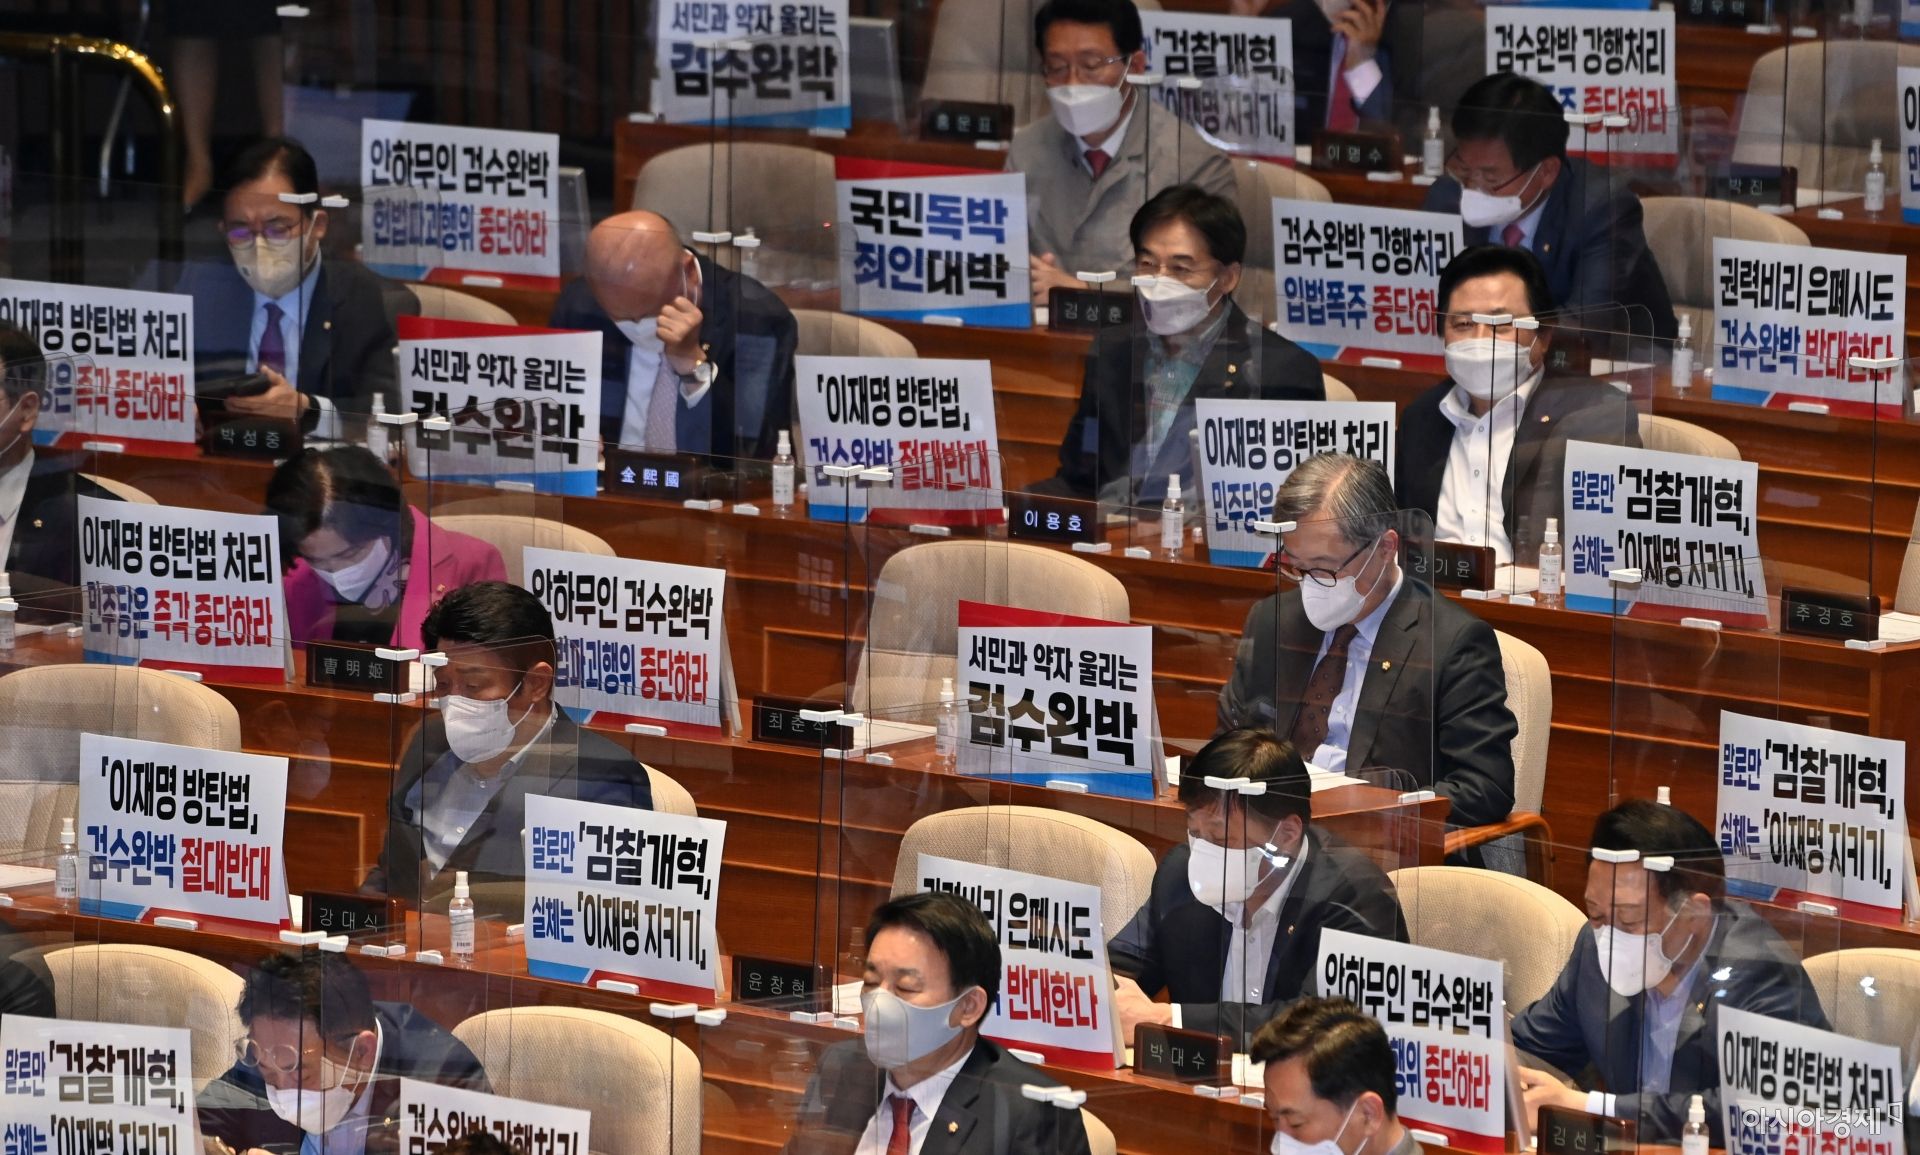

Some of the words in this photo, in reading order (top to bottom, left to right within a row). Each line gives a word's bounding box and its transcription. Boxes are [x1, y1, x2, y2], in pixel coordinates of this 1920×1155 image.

[672, 4, 729, 34] 서민과
[736, 7, 774, 36] 약자
[781, 6, 836, 37] 울리는
[671, 41, 837, 101] 검수완박
[1495, 25, 1577, 74] 검수완박
[1583, 27, 1666, 75] 강행처리
[1584, 87, 1667, 134] 중단하라
[371, 139, 456, 190] 안하무인
[463, 146, 549, 198] 검수완박
[373, 198, 474, 252] 헌법파괴행위
[479, 206, 547, 257] 중단하라
[850, 187, 1008, 244] 국민독박
[854, 242, 1010, 298] 죄인대박
[1281, 217, 1365, 270] 검수완박
[1370, 226, 1455, 276] 강행처리
[1284, 277, 1367, 330] 입법폭주
[1373, 286, 1440, 336] 중단하
[1720, 257, 1803, 313] 권력비리
[1807, 265, 1894, 321] 은폐시도
[71, 304, 136, 358] 방탄법
[143, 310, 187, 361] 처리
[1721, 319, 1800, 375] 검수완박
[1805, 329, 1893, 384] 반대한다
[76, 365, 110, 416] 즉각
[115, 369, 185, 422] 중단하라
[412, 347, 470, 384] 서민과
[477, 353, 517, 388] 약자
[523, 357, 586, 394] 울리는
[221, 428, 279, 449] 박성중
[411, 391, 585, 464] 검수완박
[1205, 417, 1267, 470] 이재명
[810, 437, 894, 489] 검수완박
[898, 439, 992, 491] 절대반대
[1572, 471, 1614, 513] 말로만
[1024, 510, 1082, 532] 이용호
[83, 516, 142, 573] 이재명
[150, 525, 216, 581] 방탄법
[223, 532, 272, 584] 처리
[1414, 556, 1472, 578] 강기윤
[1572, 535, 1614, 577] 실체는
[88, 581, 149, 639] 민주당은
[154, 590, 188, 642] 즉각
[195, 594, 272, 647] 중단하라
[532, 568, 618, 628] 안하무인
[625, 580, 713, 639] 검수완박
[1796, 604, 1854, 627] 추경호
[555, 636, 636, 695] 법파괴행위
[640, 647, 708, 705] 중단하라
[969, 635, 1027, 677] 서민과
[1033, 643, 1073, 683] 약자
[1078, 650, 1138, 693] 울리는
[968, 681, 1137, 766] 검수완박
[1723, 743, 1761, 790] 말로만
[87, 825, 176, 888] 검수완박
[181, 837, 271, 901] 절대반대
[532, 827, 575, 874] 말로만
[1721, 812, 1761, 860] 실체는
[319, 908, 378, 933] 강대식
[532, 896, 574, 943] 실체는
[1008, 892, 1093, 959] 은폐시도
[749, 972, 805, 999] 윤창현
[1007, 964, 1098, 1030] 반대한다
[1325, 953, 1406, 1022] 안하무인
[1412, 969, 1493, 1038] 검수완박
[5, 1048, 46, 1097] 말로만
[1150, 1043, 1205, 1070] 박대수
[1426, 1044, 1491, 1112] 중단하라
[1723, 1031, 1778, 1100] 이재명
[1783, 1047, 1842, 1112] 방탄법
[1849, 1062, 1894, 1126] 처리
